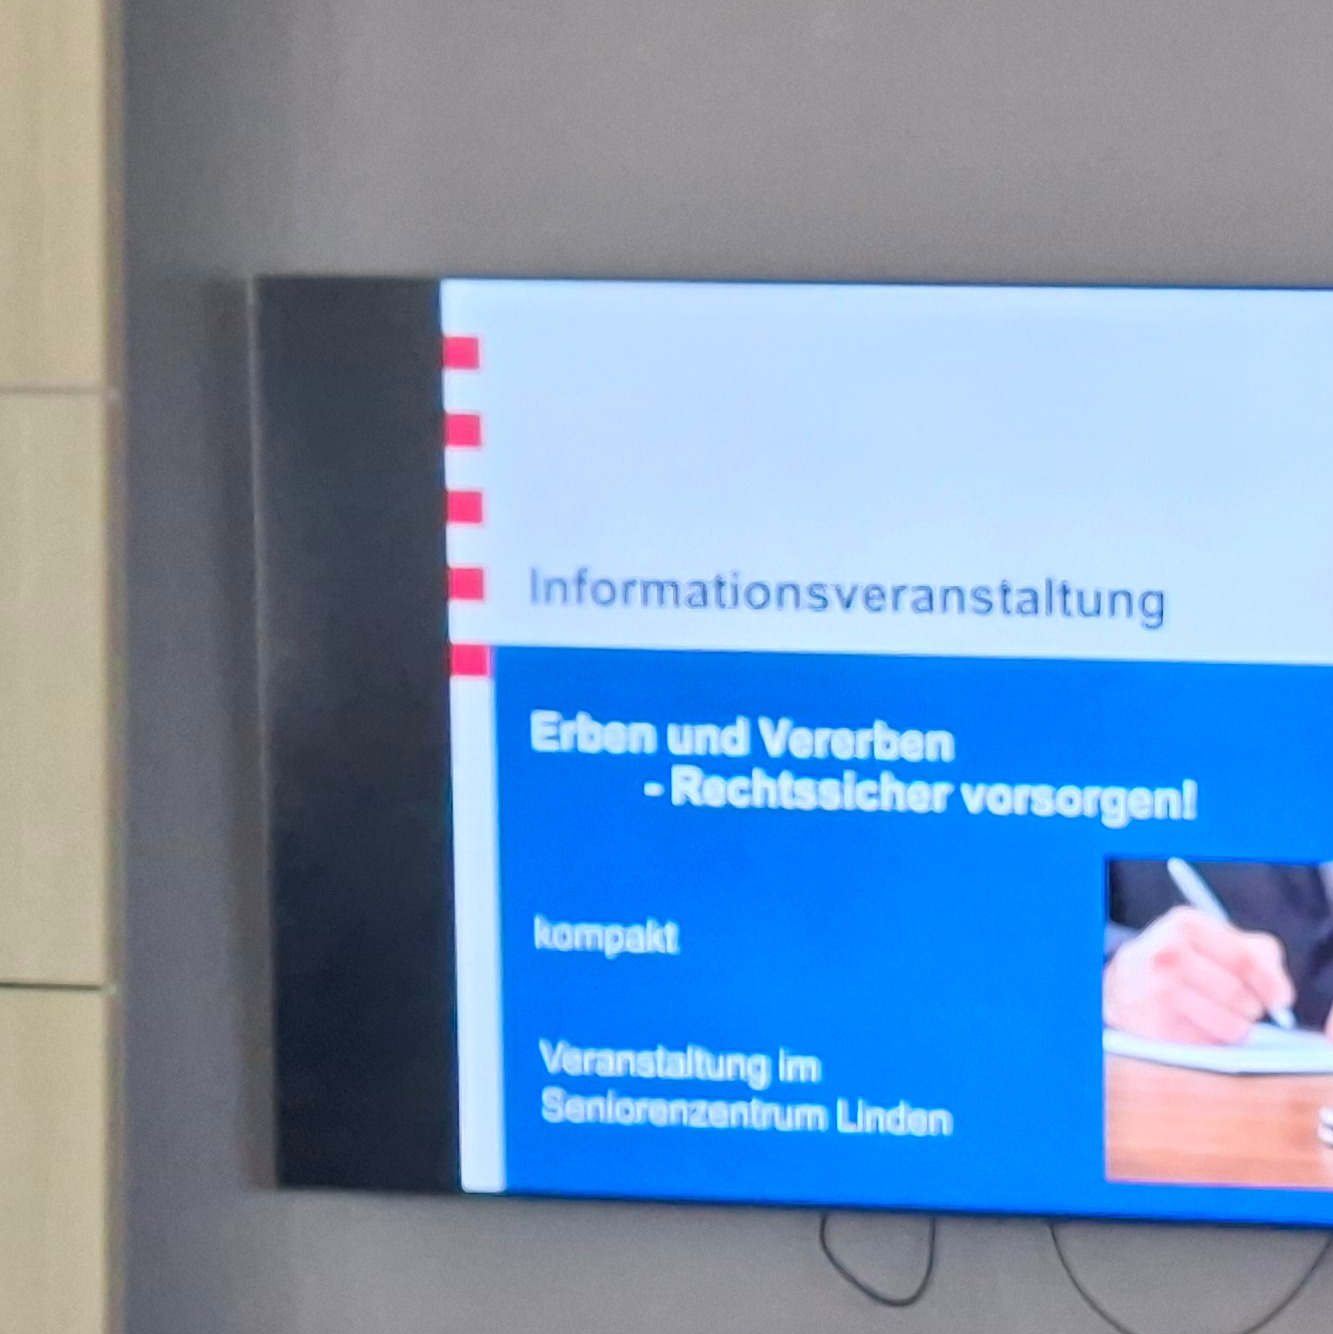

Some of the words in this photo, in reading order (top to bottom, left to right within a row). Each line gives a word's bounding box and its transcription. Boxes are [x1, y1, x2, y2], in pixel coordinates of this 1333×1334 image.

[529, 566, 1166, 629] Informationsveranstaltung
[529, 709, 658, 755] Erben
[666, 714, 750, 757] und
[757, 716, 956, 763] Vererben
[670, 764, 954, 813] Rechtssicher
[960, 779, 1198, 829] vorsorgen!
[533, 913, 681, 959] kompakt
[538, 1038, 772, 1091] Veranstaltung
[778, 1046, 821, 1083] im
[541, 1085, 828, 1132] Seniorenzentrum
[836, 1097, 954, 1137] Linden
